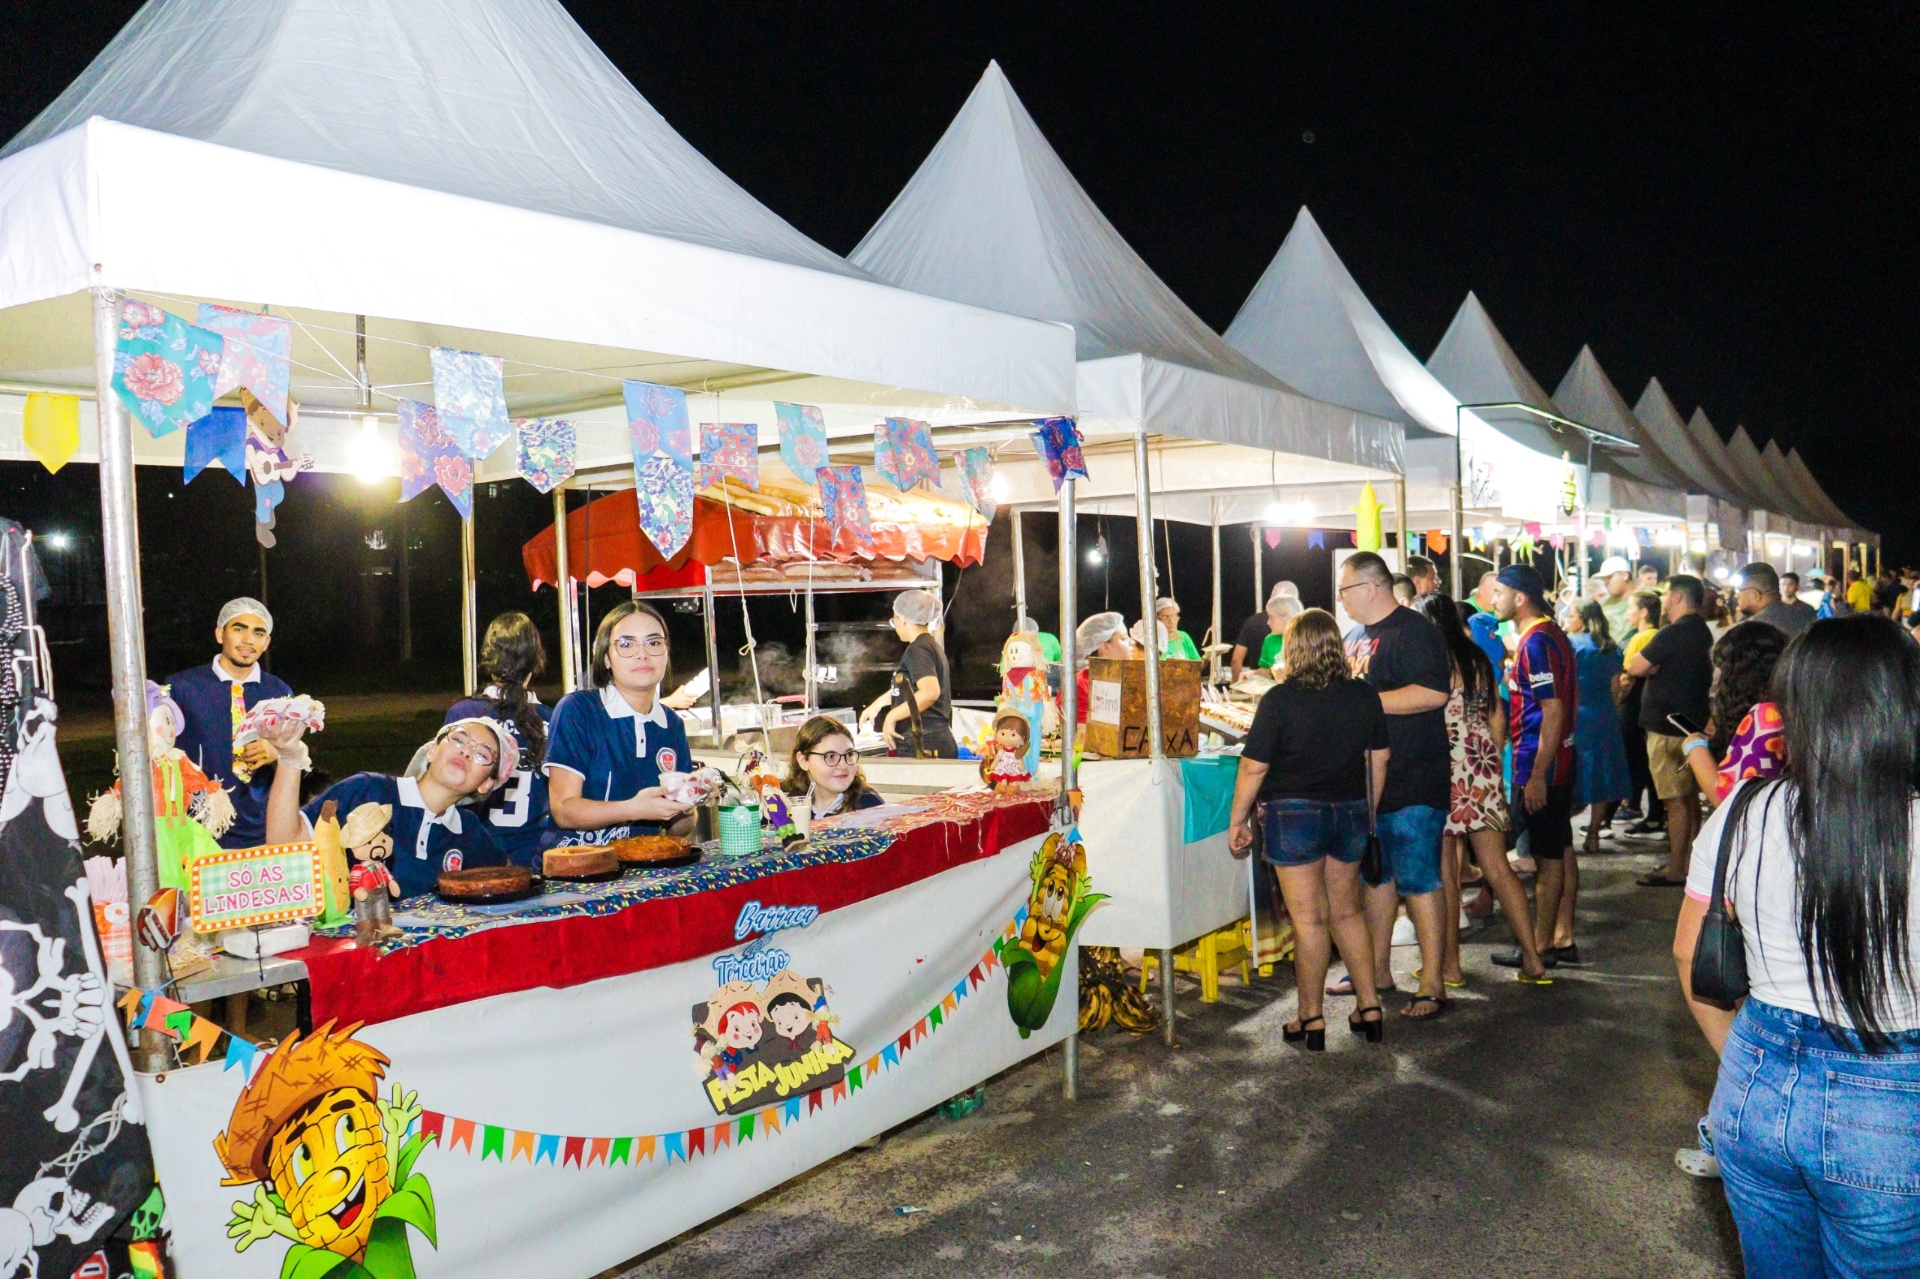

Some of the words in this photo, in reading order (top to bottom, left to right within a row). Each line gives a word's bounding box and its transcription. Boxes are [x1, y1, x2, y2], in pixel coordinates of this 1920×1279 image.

[1528, 671, 1554, 682] beko
[1122, 725, 1195, 754] CAXA
[488, 768, 532, 827] 3
[229, 863, 253, 888] SÓ
[259, 866, 284, 883] AS
[204, 883, 311, 915] LINDESAS!
[736, 901, 817, 939] Barraca
[714, 950, 789, 986] Terceirão
[706, 1060, 778, 1112] FESTA
[773, 1037, 855, 1097] JUNINA
